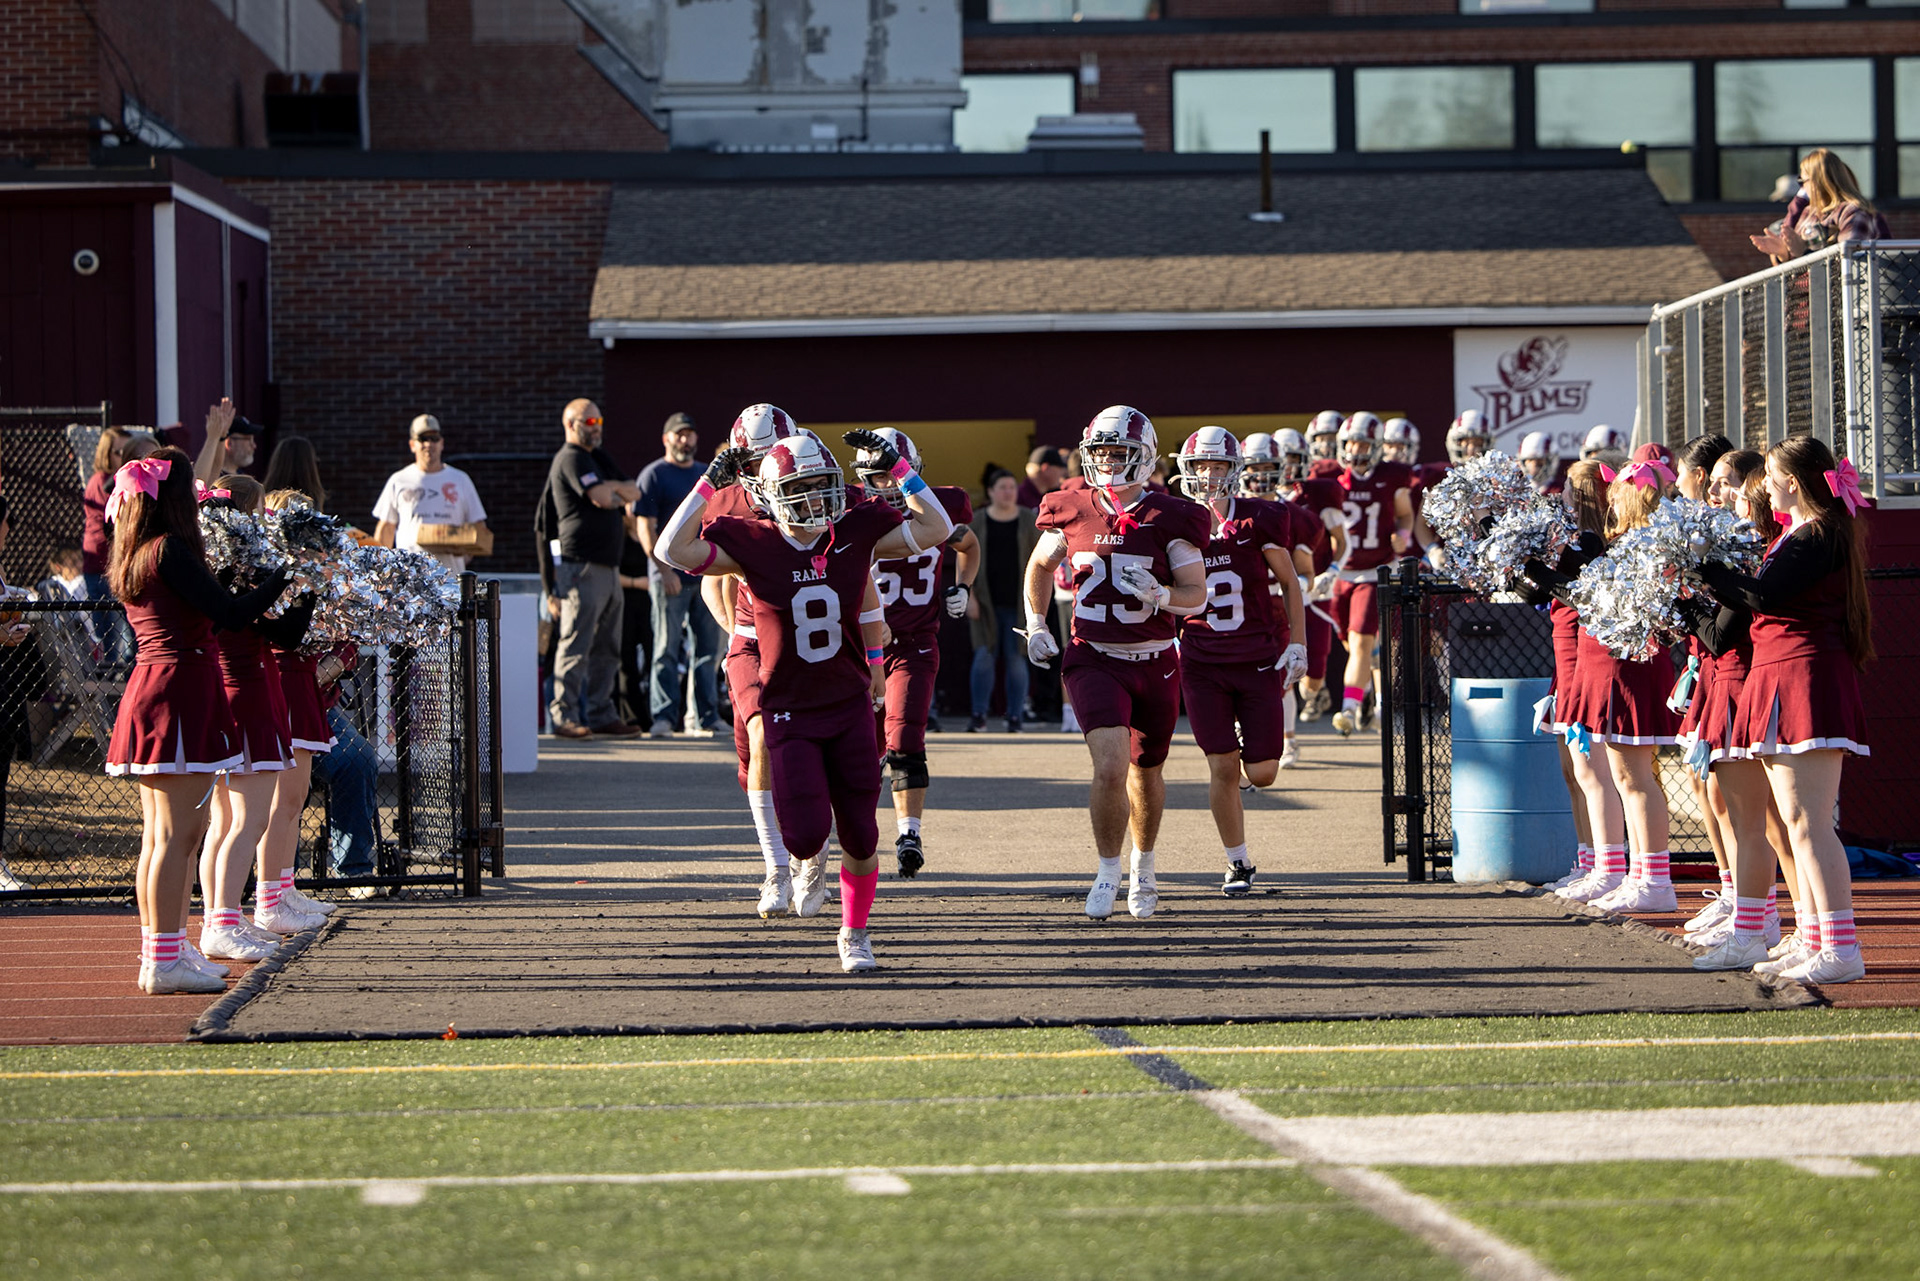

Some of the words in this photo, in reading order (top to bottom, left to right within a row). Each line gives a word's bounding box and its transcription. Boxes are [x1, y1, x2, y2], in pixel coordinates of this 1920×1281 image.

[1490, 388, 1581, 430] RAMS
[1093, 534, 1124, 545] RAMS
[1205, 555, 1231, 567] RAMS
[792, 569, 827, 582] RAMS
[870, 546, 941, 606] 53
[1071, 551, 1154, 624] 25
[1205, 570, 1245, 631] 9
[791, 584, 842, 663] 8
